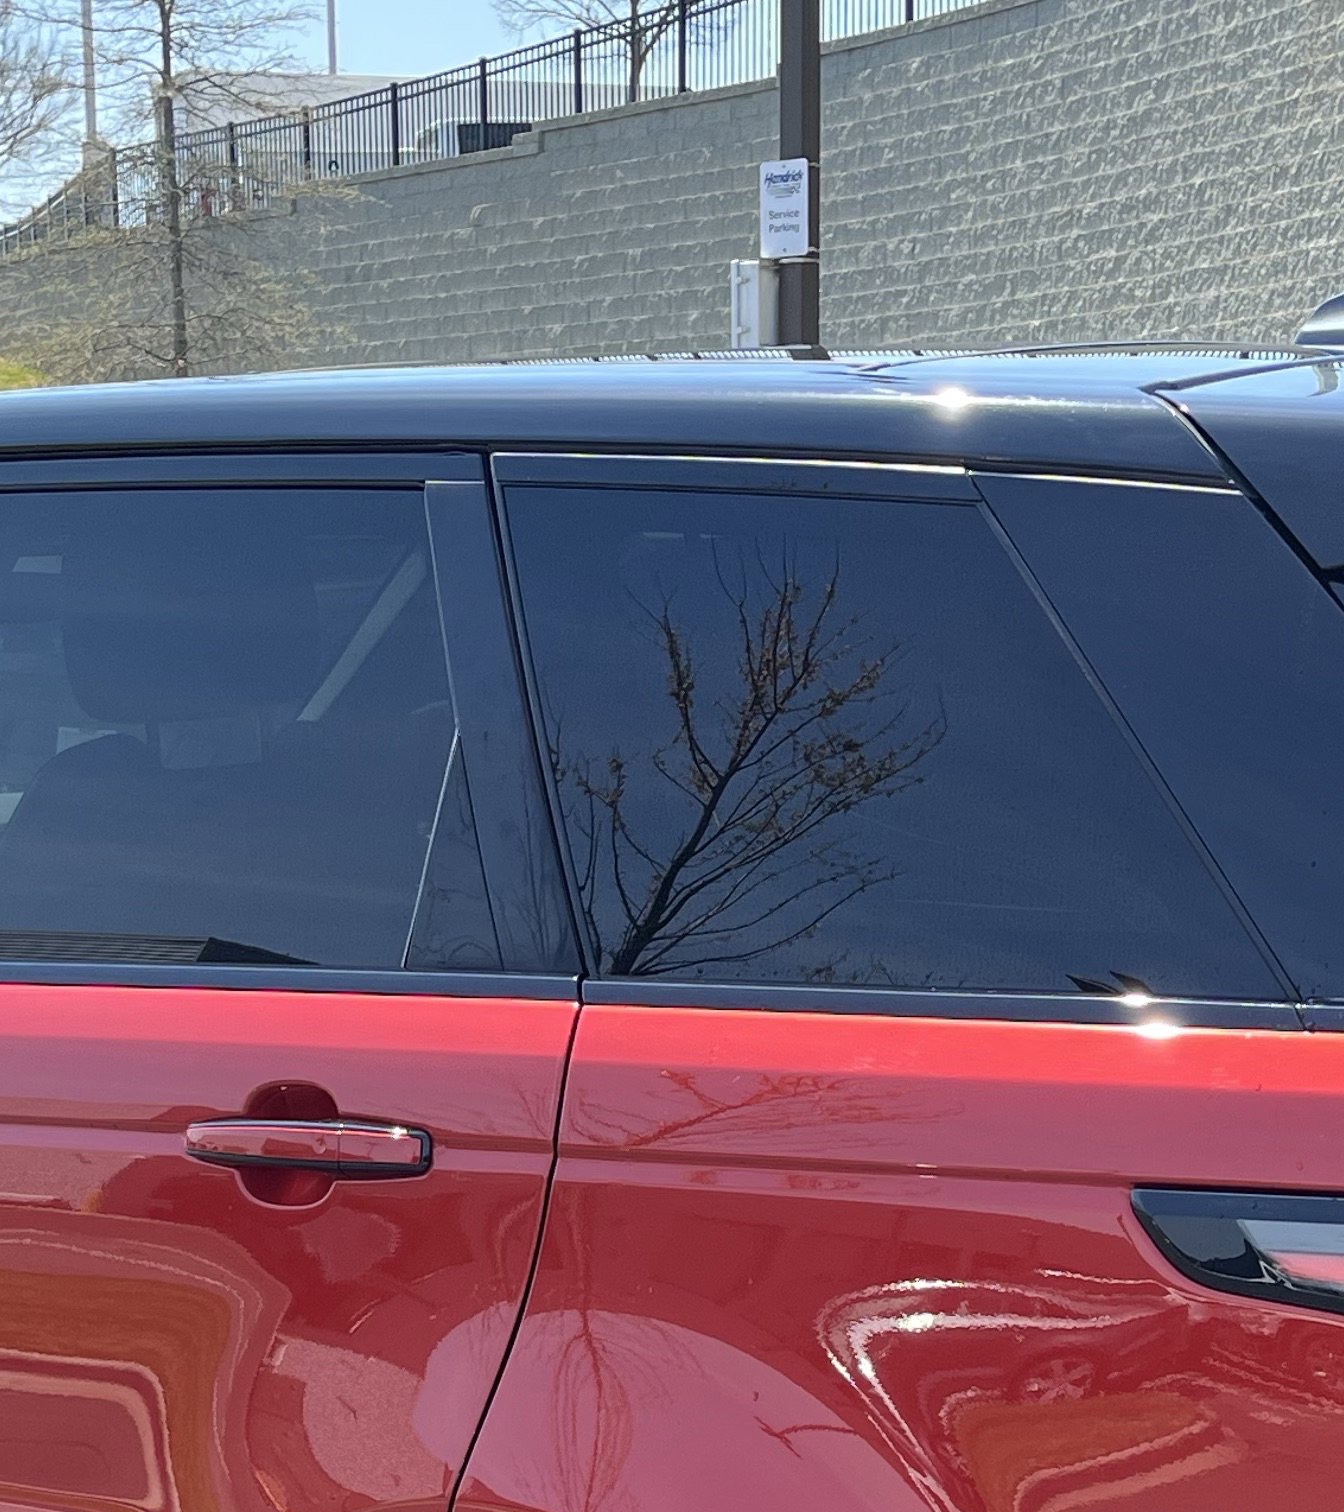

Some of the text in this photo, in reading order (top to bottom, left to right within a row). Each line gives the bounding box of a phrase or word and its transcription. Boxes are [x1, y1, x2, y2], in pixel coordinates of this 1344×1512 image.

[764, 169, 804, 188] Hendrick
[769, 209, 800, 220] Service
[769, 223, 800, 233] Parking
